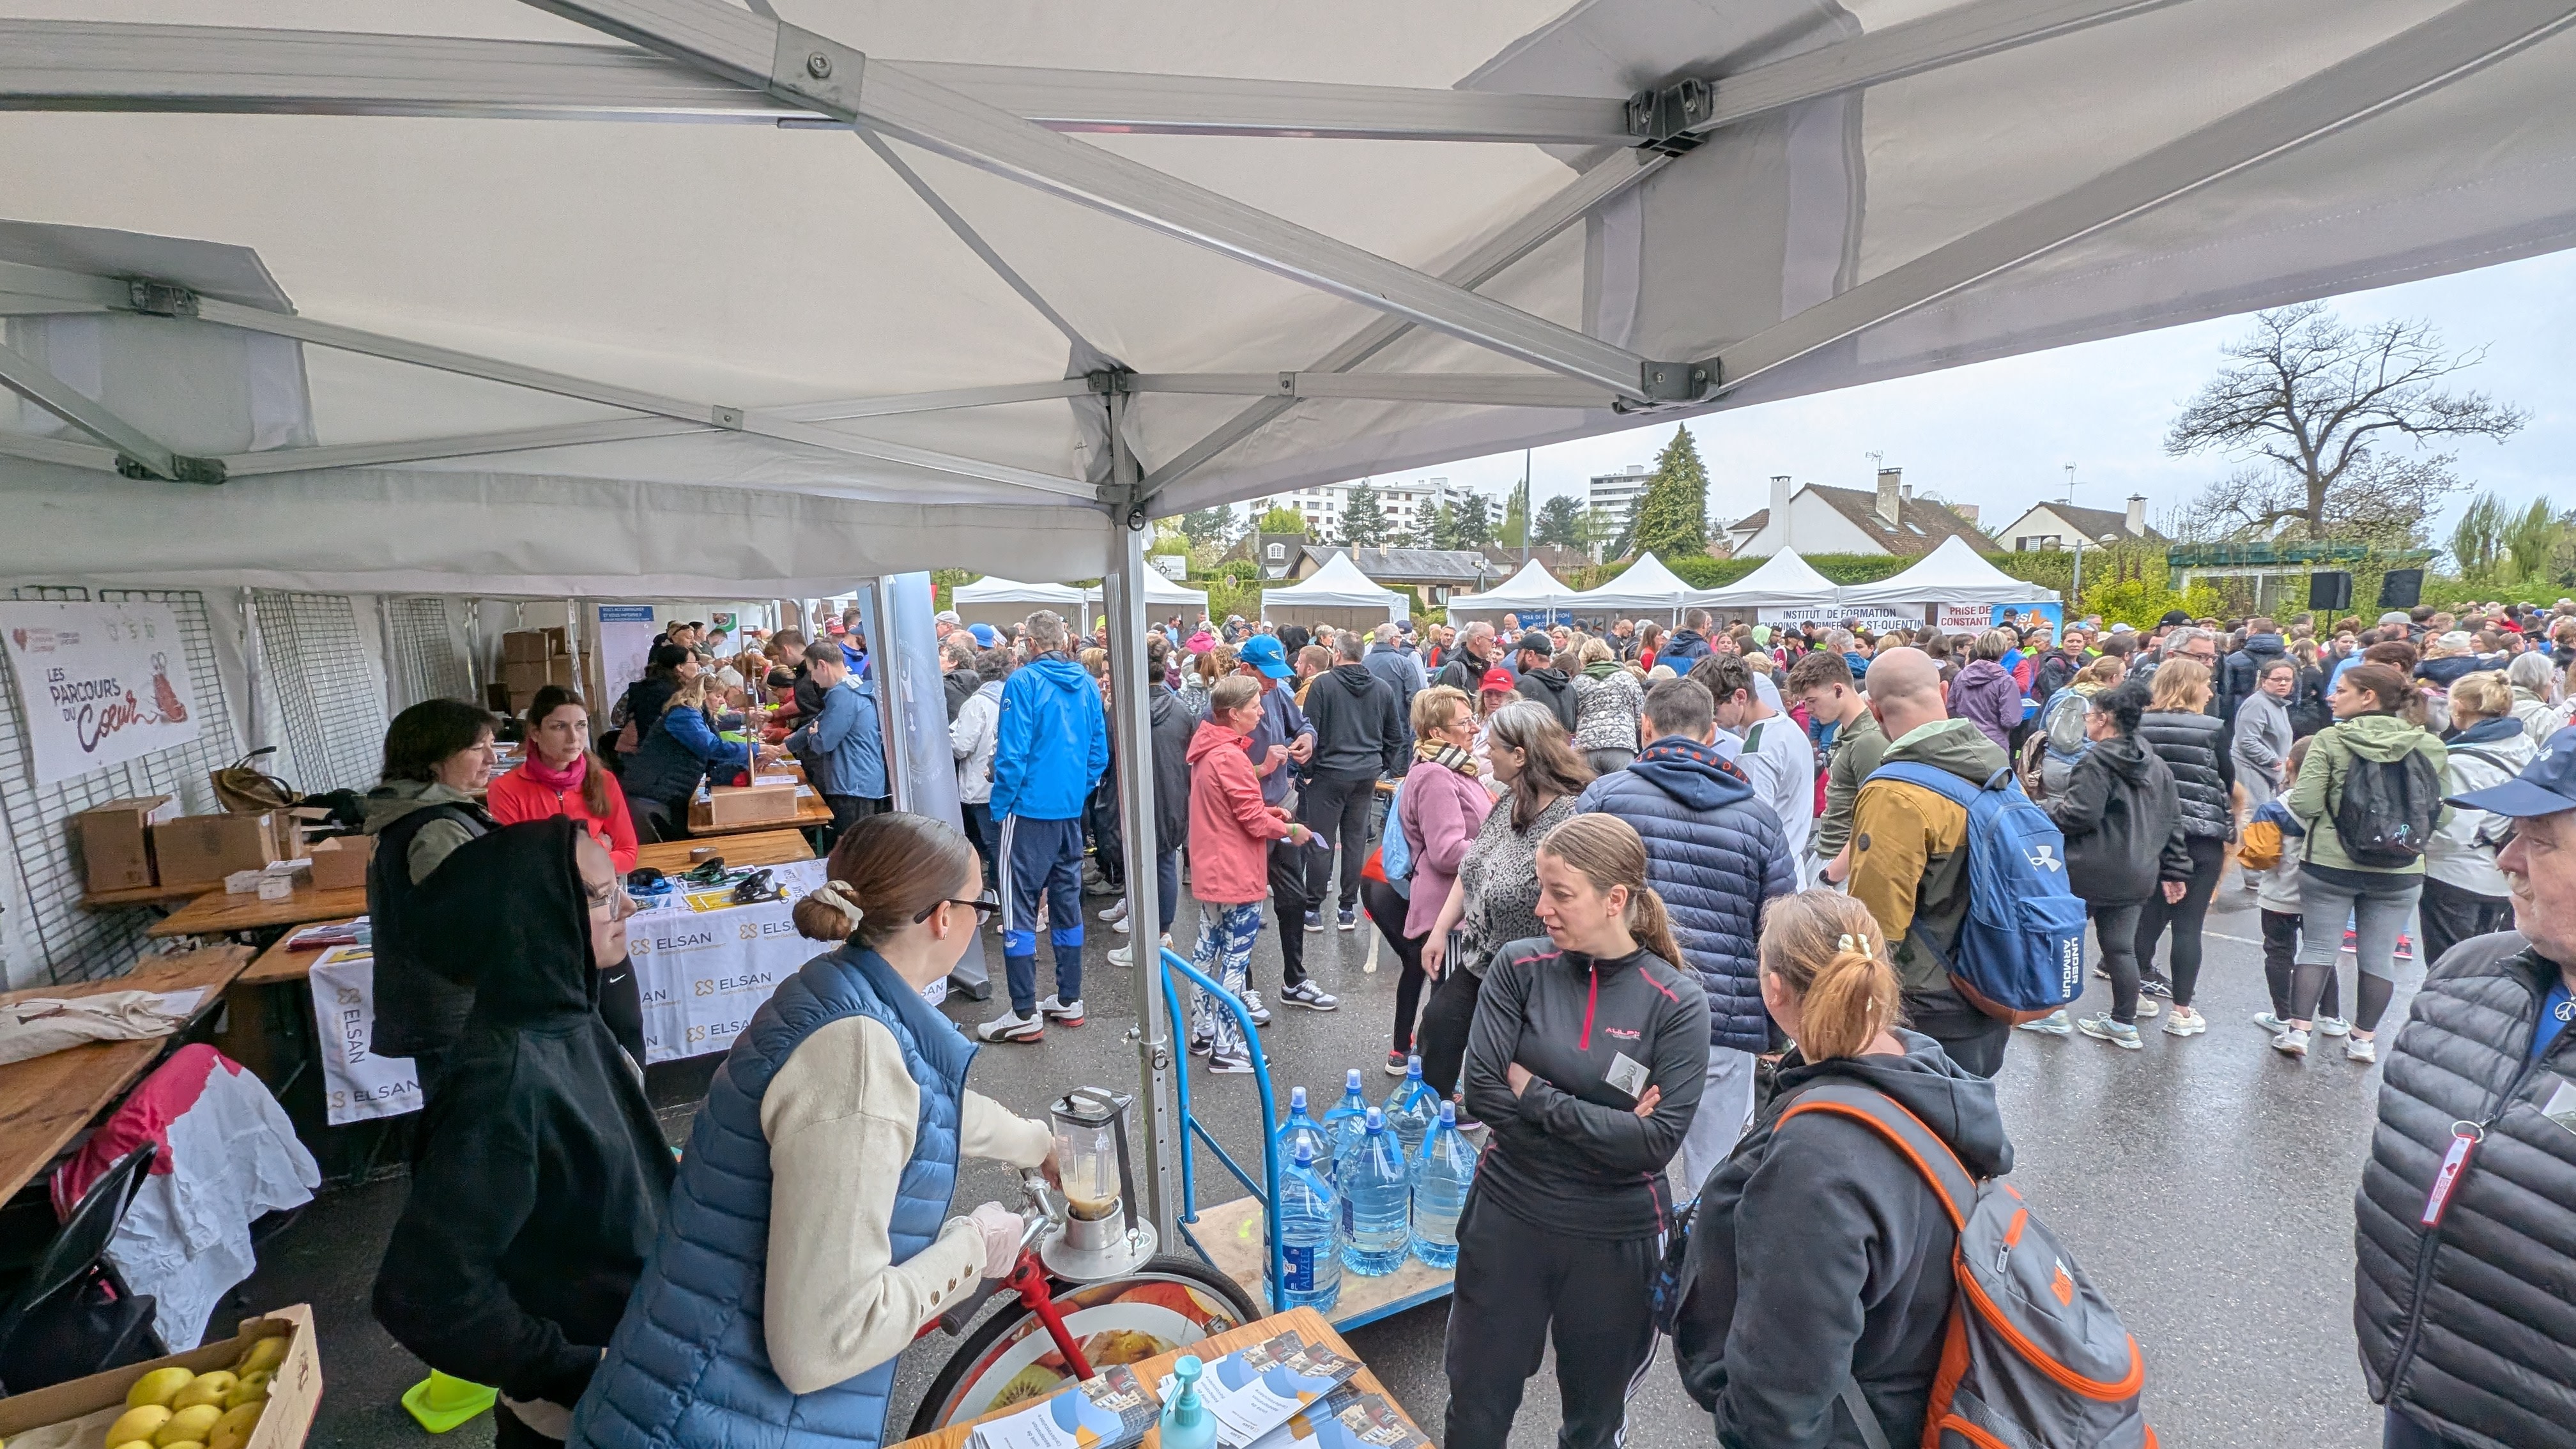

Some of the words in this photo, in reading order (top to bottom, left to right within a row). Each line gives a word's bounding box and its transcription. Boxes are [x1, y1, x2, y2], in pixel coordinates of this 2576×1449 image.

[1783, 610, 1820, 620] INSTITUT
[1827, 609, 1838, 618] DE
[1841, 608, 1897, 619] FORMATION
[1950, 606, 1976, 615] PRISE
[1979, 606, 1991, 614] DE
[1866, 619, 1924, 630] ST-QUENTIN
[47, 668, 65, 682] LES
[49, 678, 121, 706] PARCOURS
[63, 707, 76, 722] DU
[763, 921, 795, 934] ELS
[657, 931, 712, 949] ELSAN
[2062, 939, 2071, 998] ARMOUR
[719, 972, 772, 990] ELSAN
[711, 1020, 750, 1035] ELSA
[343, 1009, 365, 1064] ELSAN
[354, 1080, 420, 1102] ELSAN
